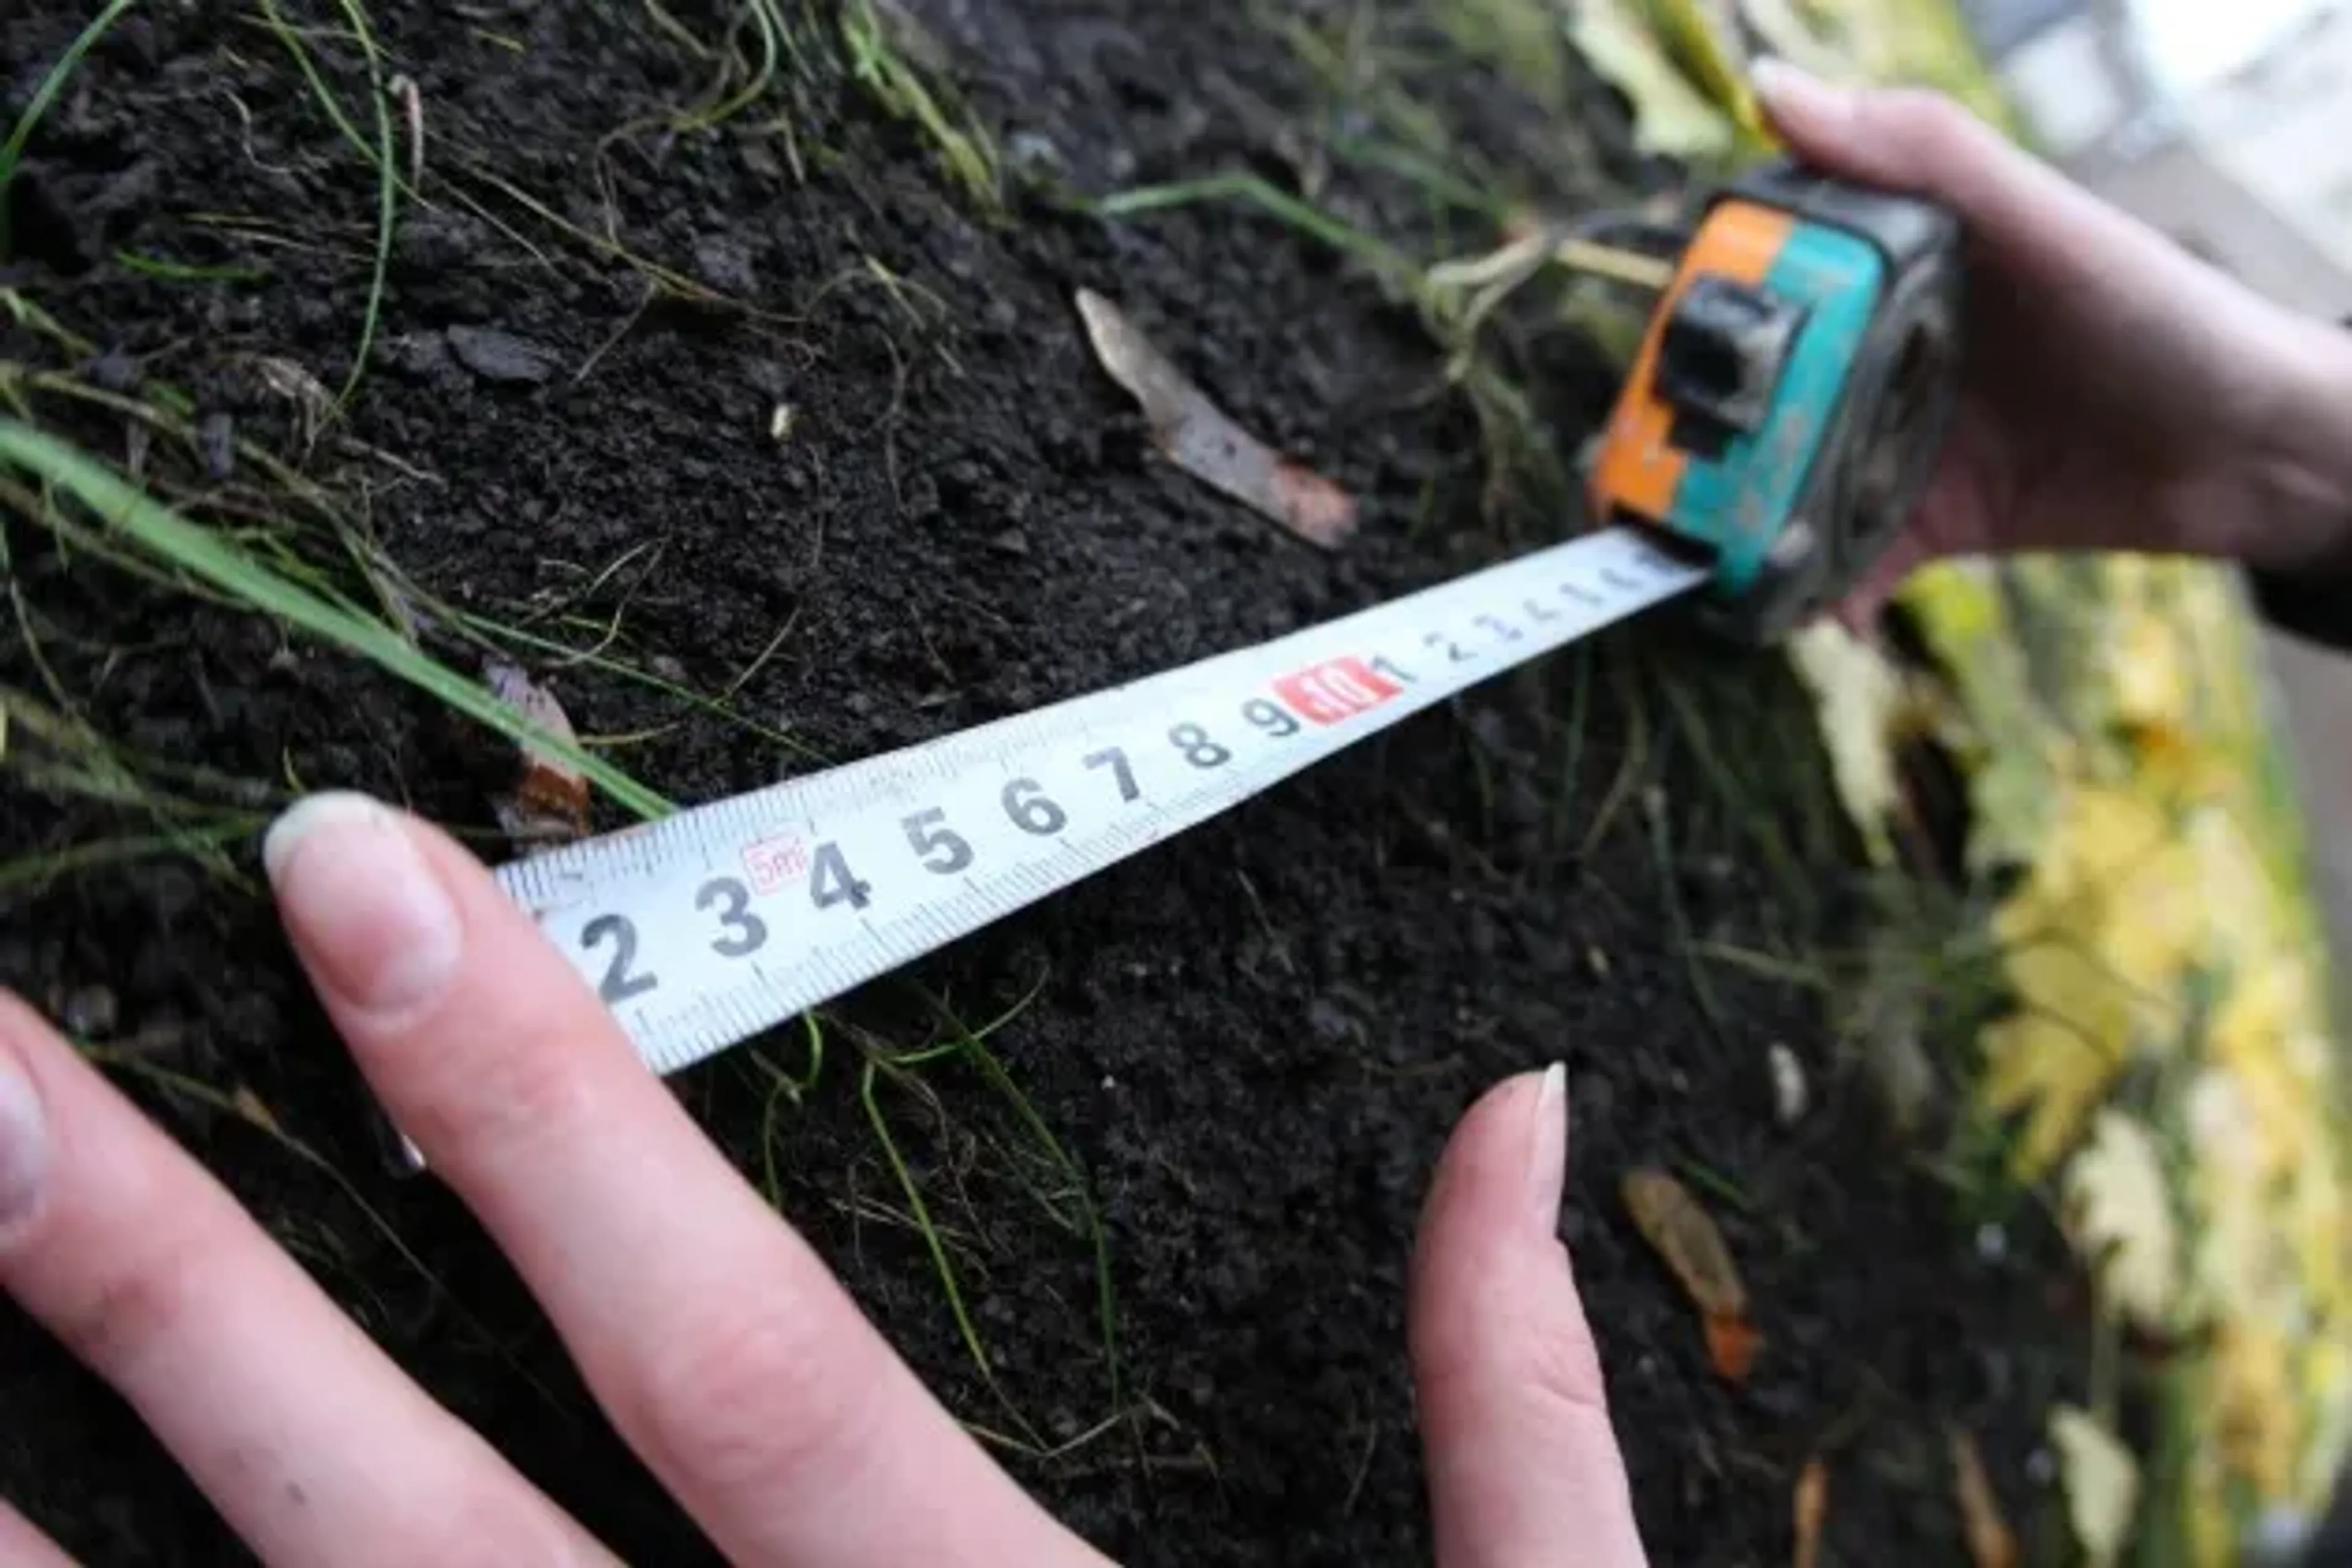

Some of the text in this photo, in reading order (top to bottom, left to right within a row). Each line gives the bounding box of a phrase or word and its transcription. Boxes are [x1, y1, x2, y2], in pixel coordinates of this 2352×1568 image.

[581, 914, 657, 1002] 2
[695, 877, 767, 957] 3
[810, 840, 872, 910] 4
[901, 806, 974, 875] 5
[1001, 777, 1066, 835] 6
[1083, 746, 1140, 803] 7
[1169, 722, 1231, 769] 8
[1242, 698, 1300, 736] 9
[1371, 654, 1417, 684] 1
